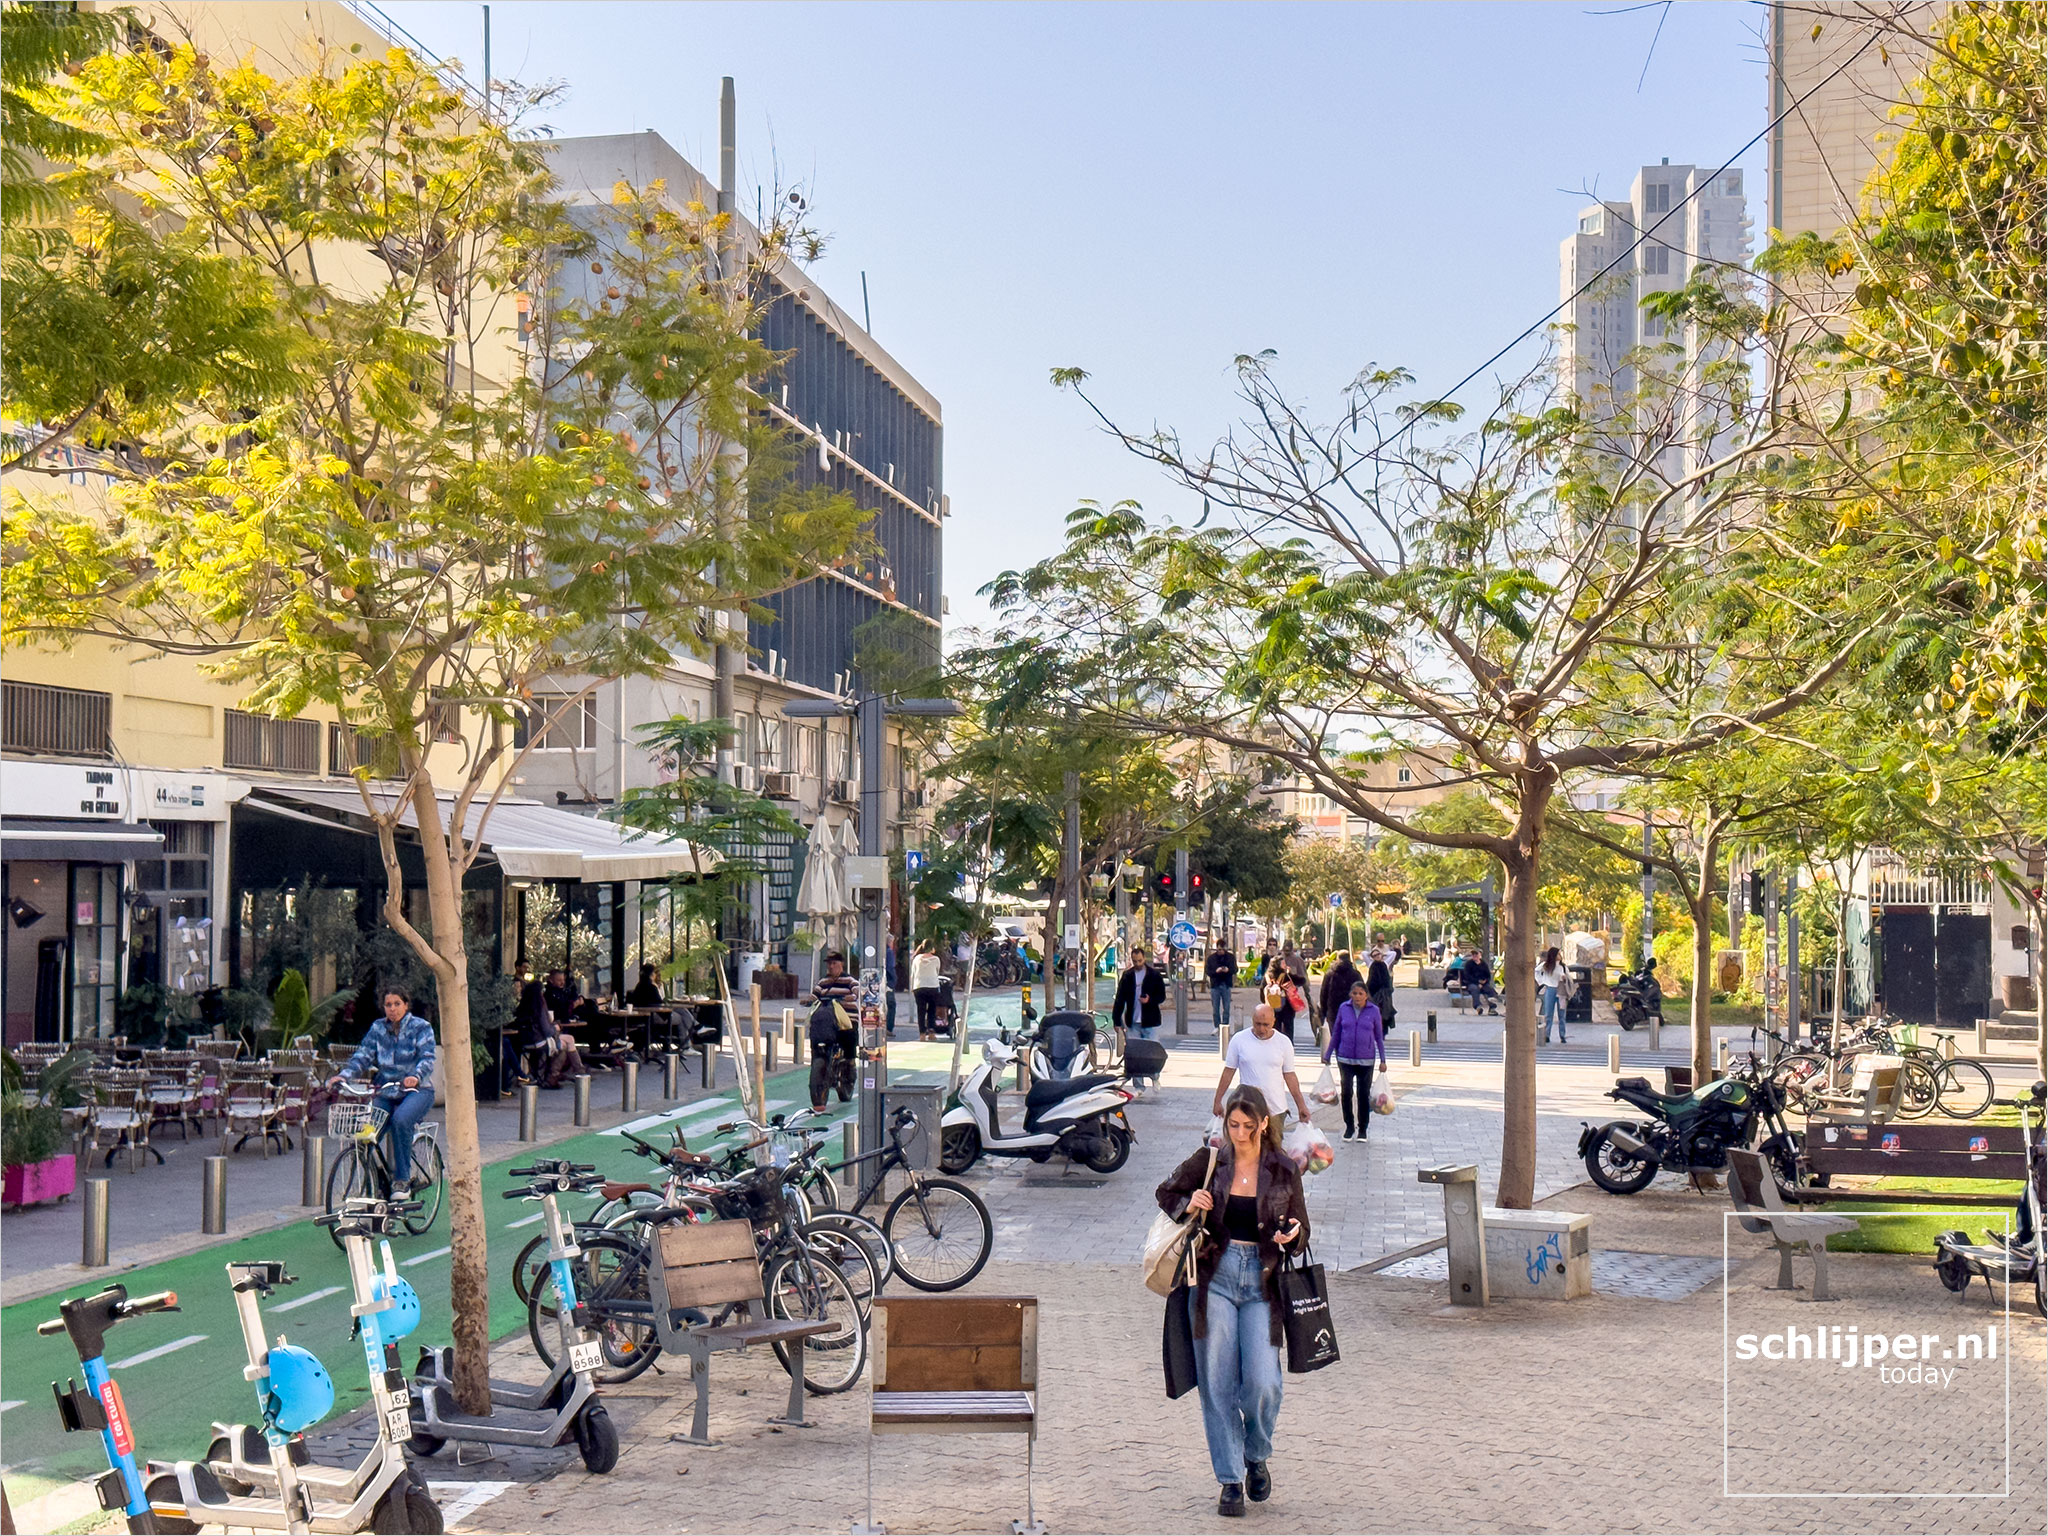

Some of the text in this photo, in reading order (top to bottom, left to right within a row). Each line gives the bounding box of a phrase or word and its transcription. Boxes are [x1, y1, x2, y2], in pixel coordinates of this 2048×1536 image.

[156, 788, 168, 803] 44
[363, 1325, 380, 1373] BIRD
[574, 1355, 601, 1370] 8588
[393, 1392, 408, 1405] 62
[392, 1413, 402, 1425] AR
[391, 1424, 409, 1440] 5067
